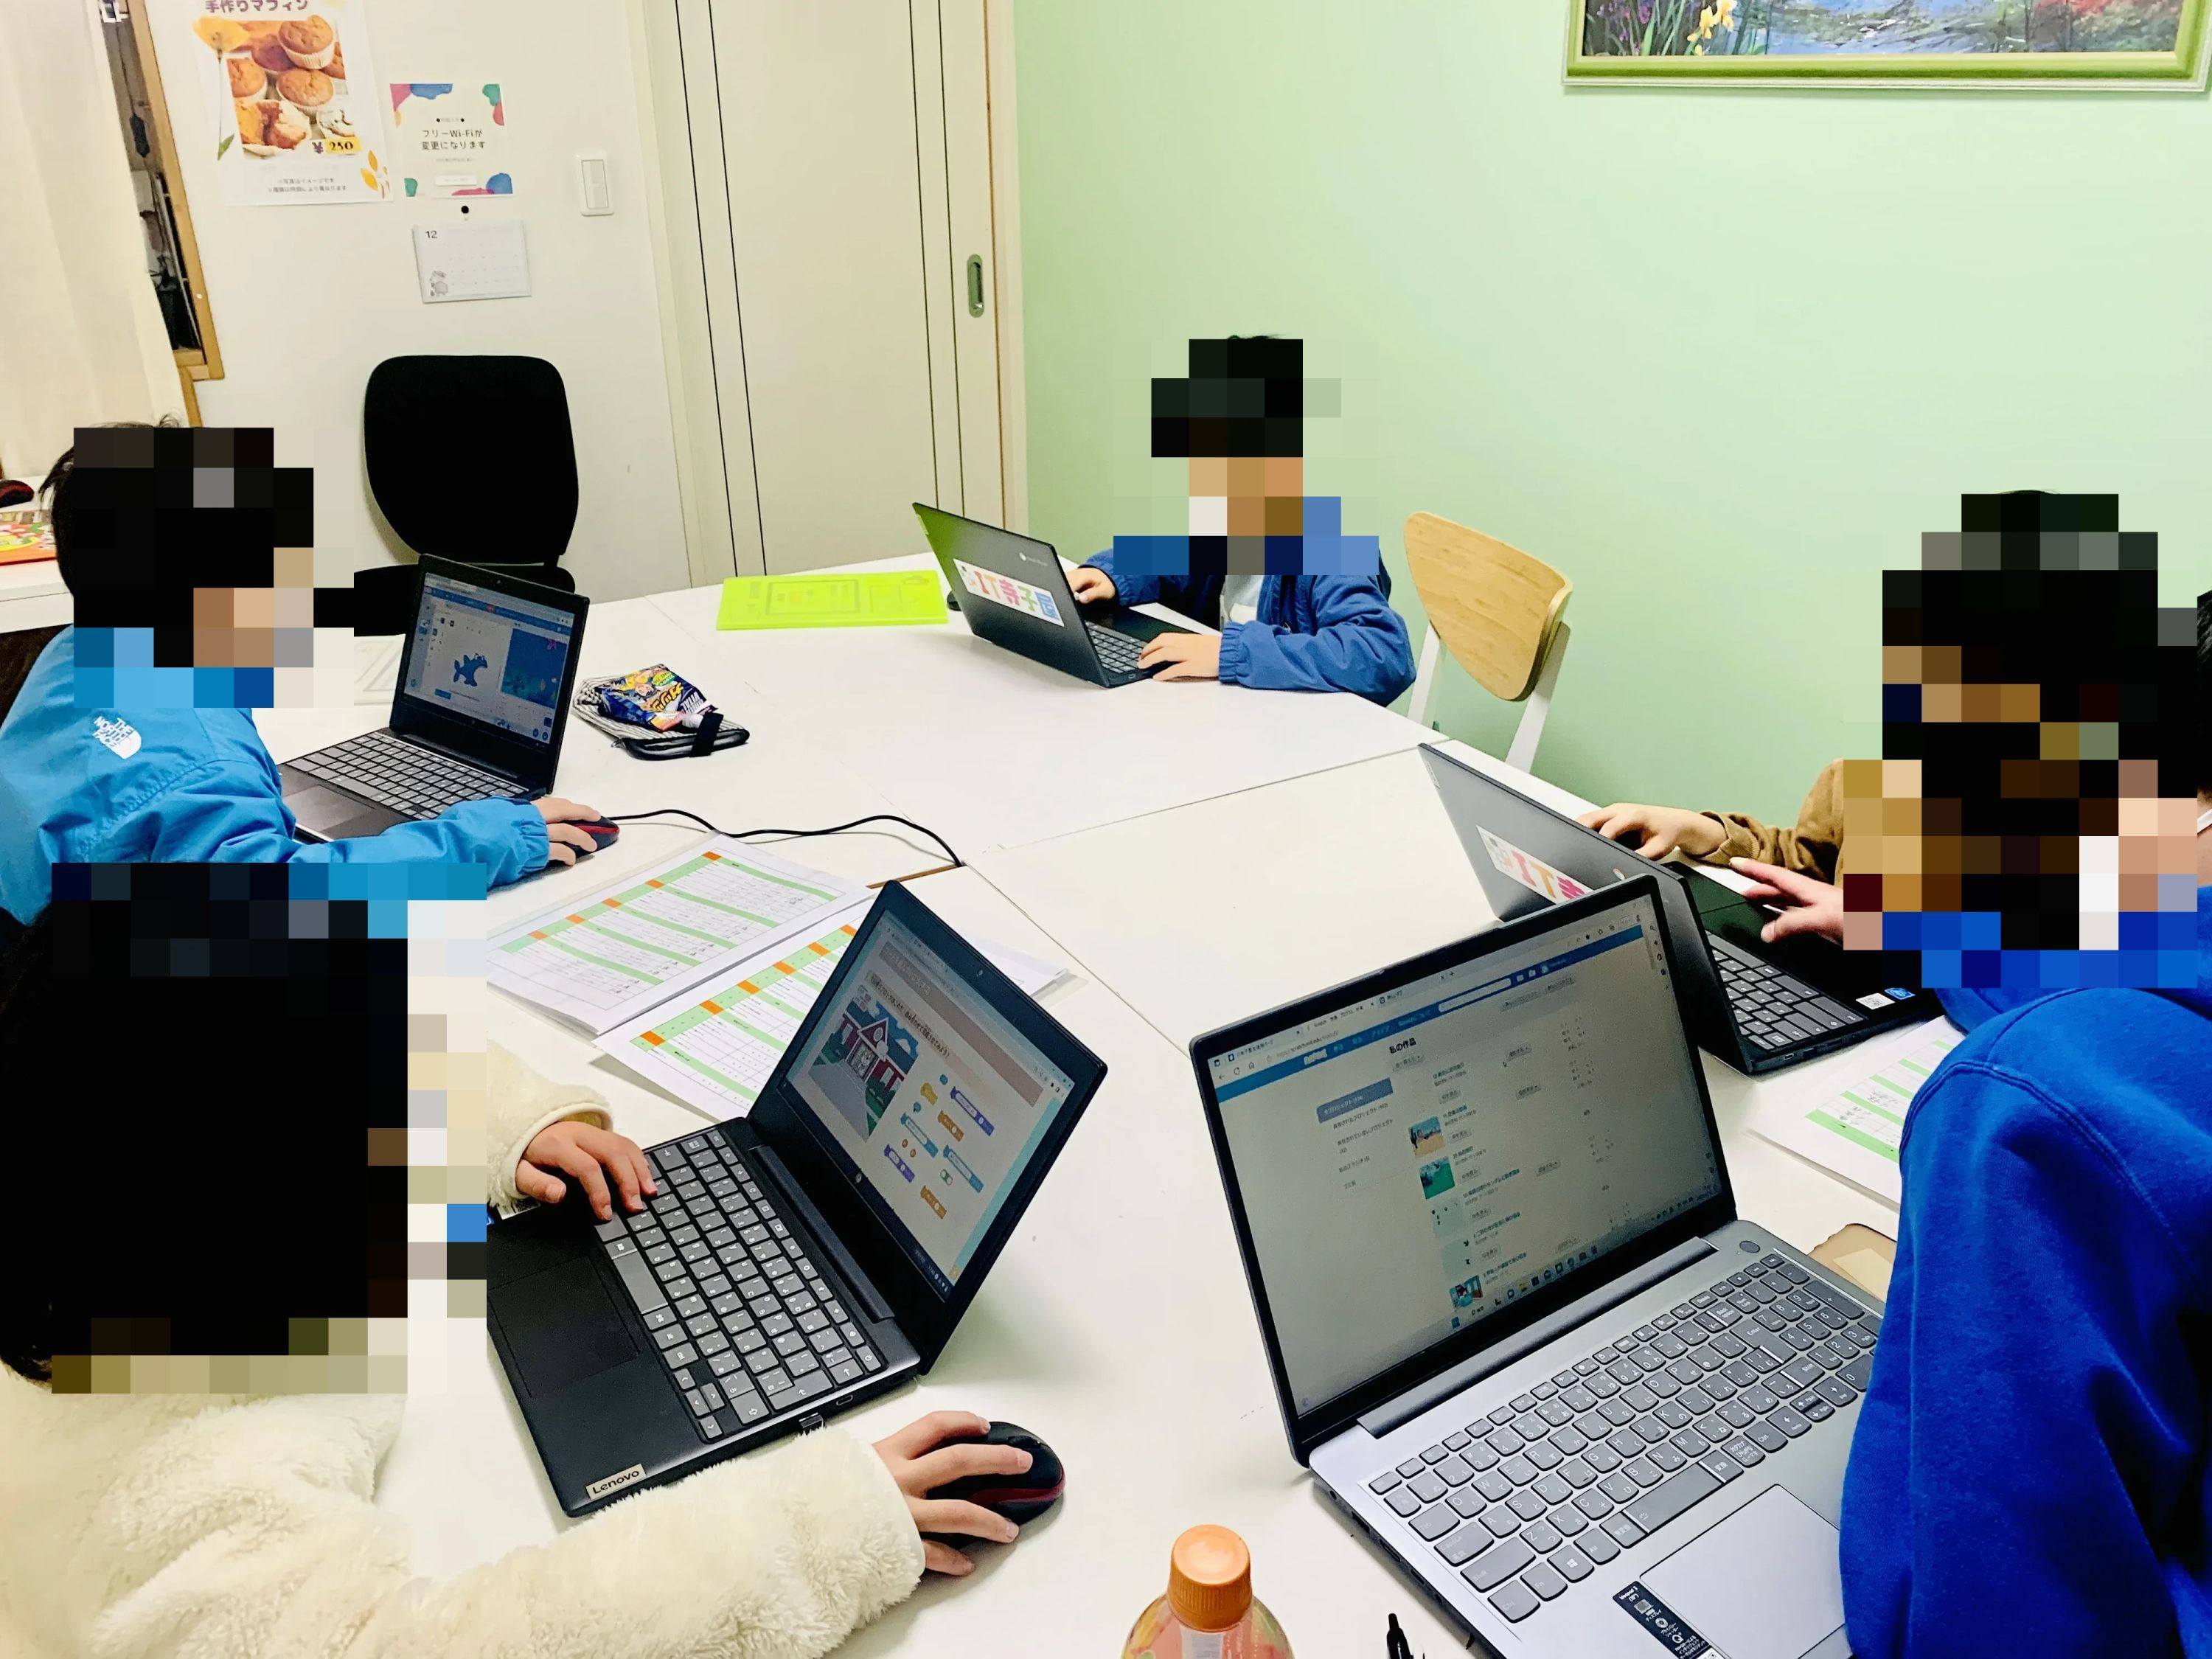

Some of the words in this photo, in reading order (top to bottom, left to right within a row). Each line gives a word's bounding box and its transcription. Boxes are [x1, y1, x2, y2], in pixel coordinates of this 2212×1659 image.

[205, 0, 308, 13] 手作りマフィン
[422, 129, 483, 138] フリーWi-Fiが
[312, 142, 324, 154] ¥
[329, 142, 354, 151] 250
[421, 141, 486, 150] 変更になります
[425, 230, 438, 238] 12
[974, 571, 1060, 621] IT寺子屋
[93, 716, 128, 742] NORTH
[114, 717, 134, 735] THE
[1388, 1036, 1416, 1055] 私の作品
[592, 1470, 639, 1494] Lenovo
